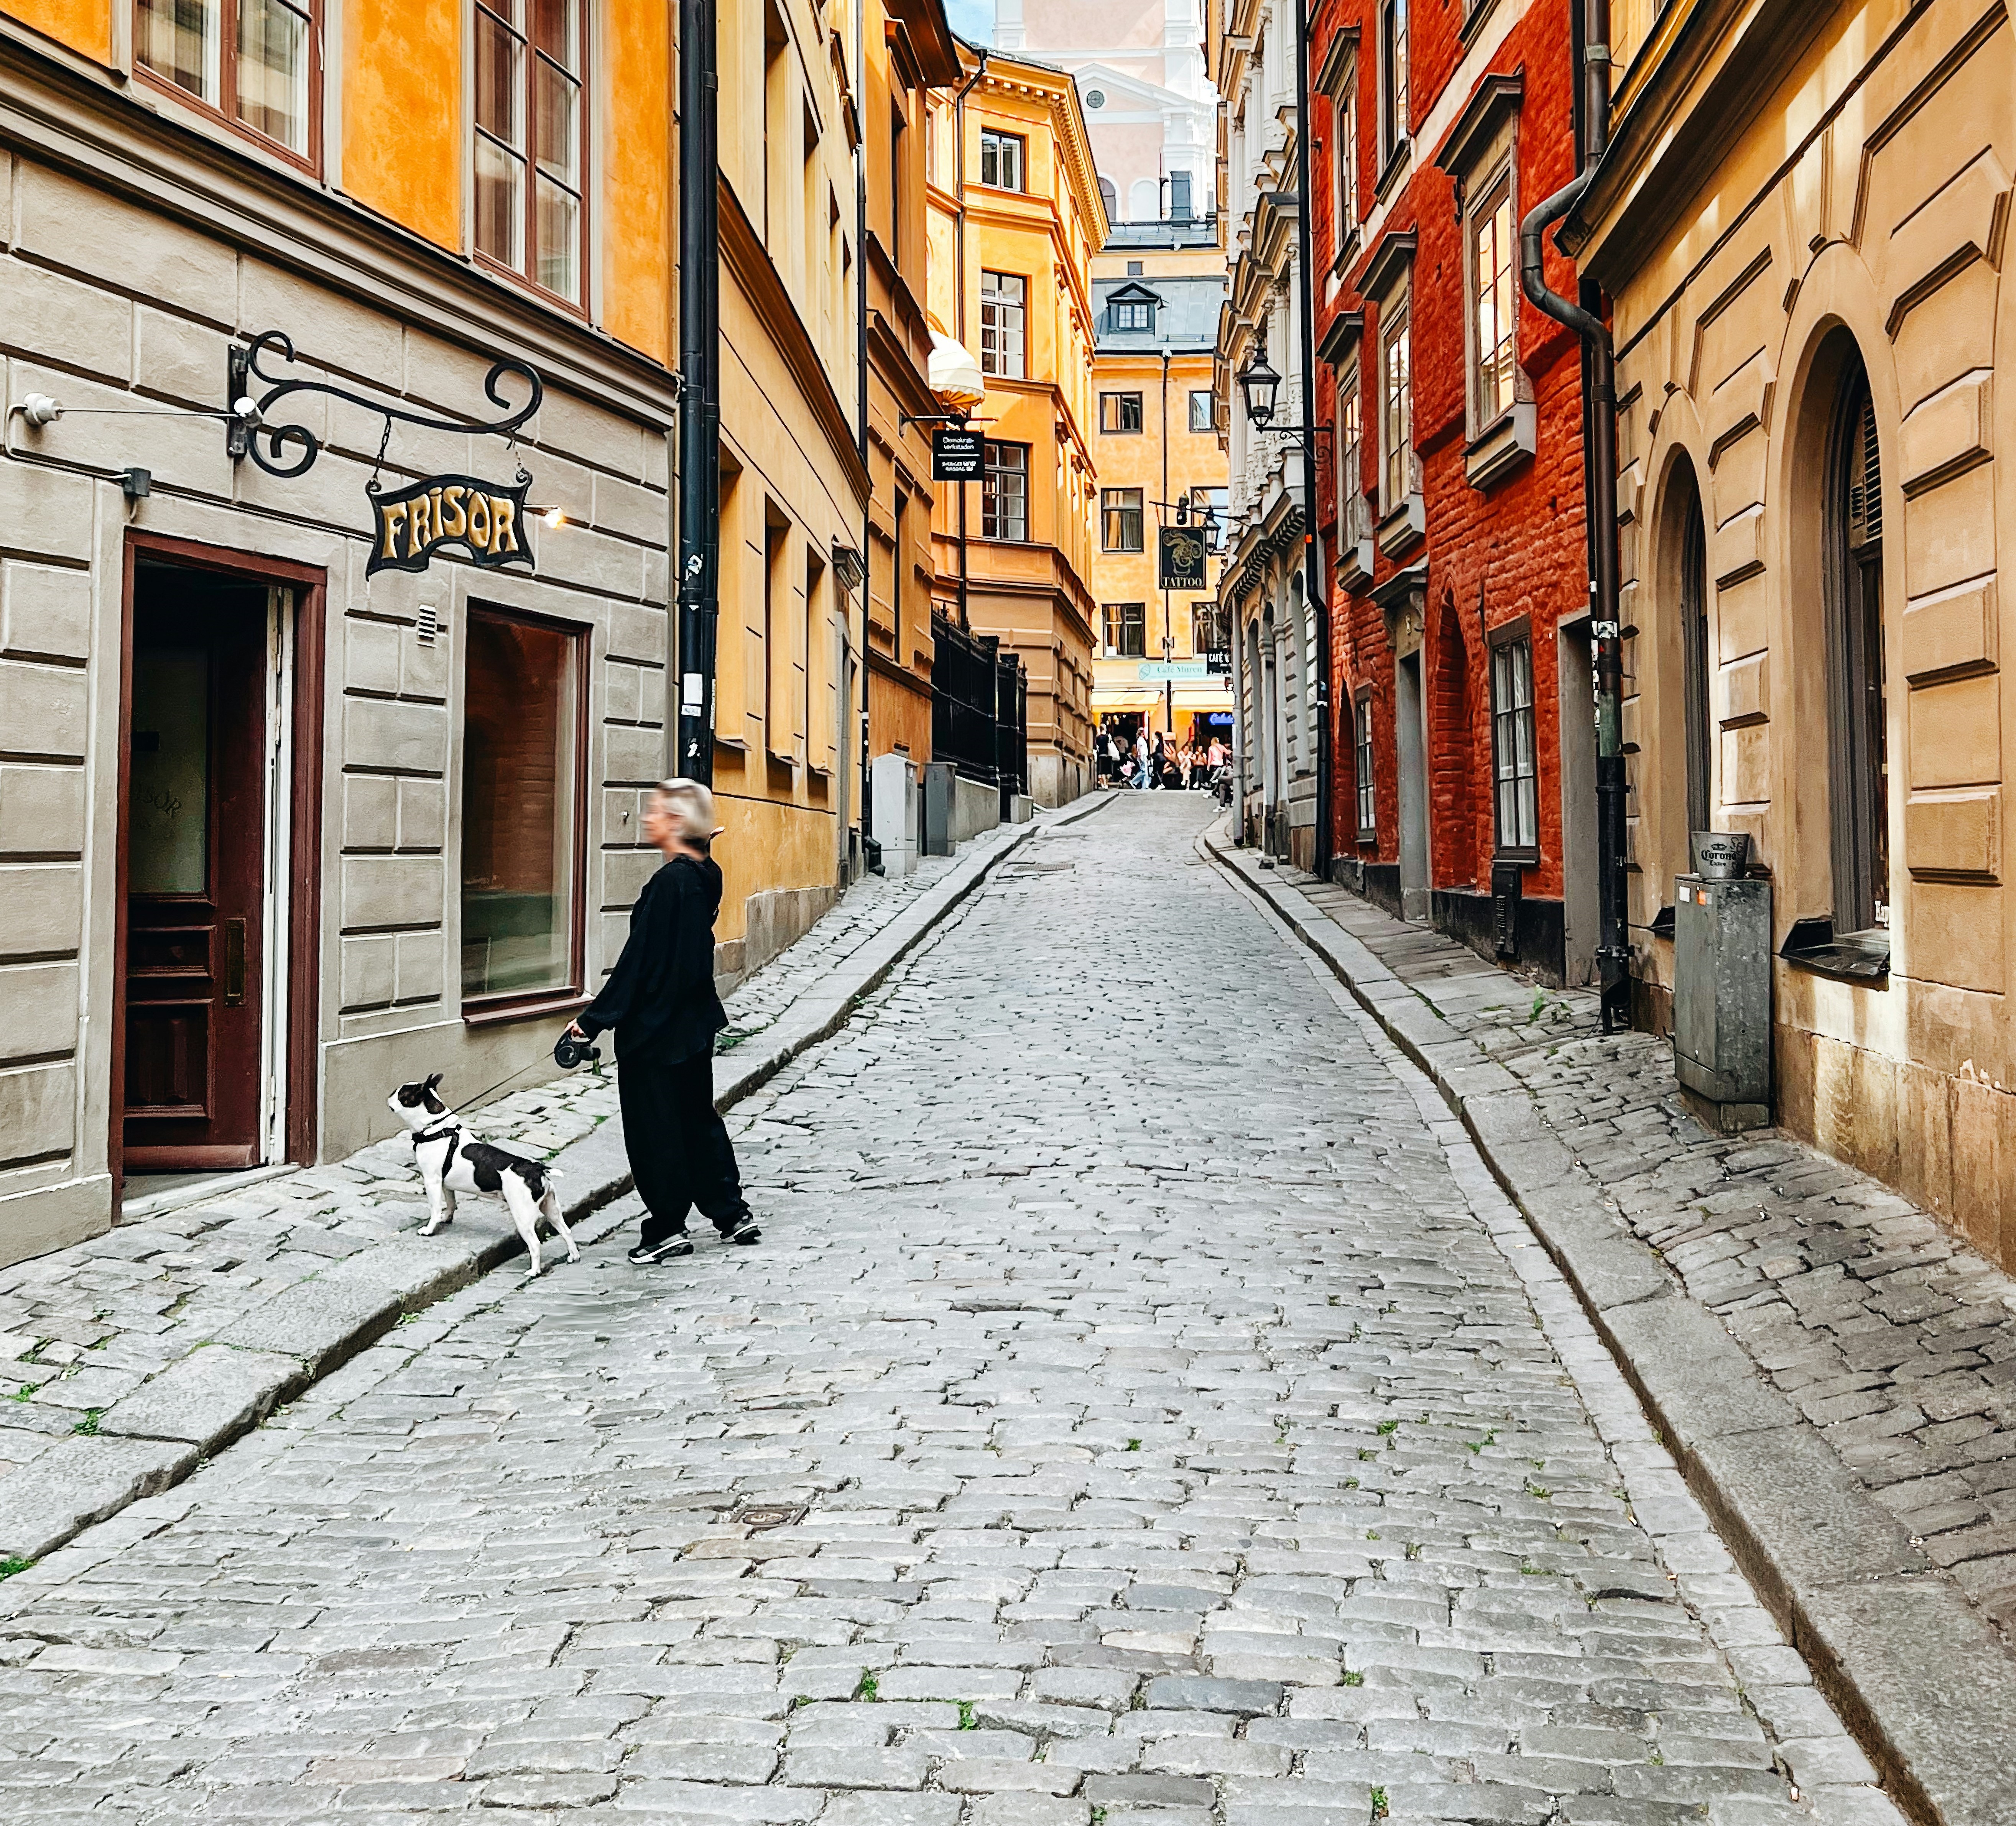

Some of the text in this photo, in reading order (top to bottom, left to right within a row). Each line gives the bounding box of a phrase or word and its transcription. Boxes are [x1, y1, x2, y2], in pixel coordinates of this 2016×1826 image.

[1163, 577, 1202, 587] TATTOO
[1209, 651, 1223, 663] CAFÉ
[1701, 850, 1737, 861] Corona
